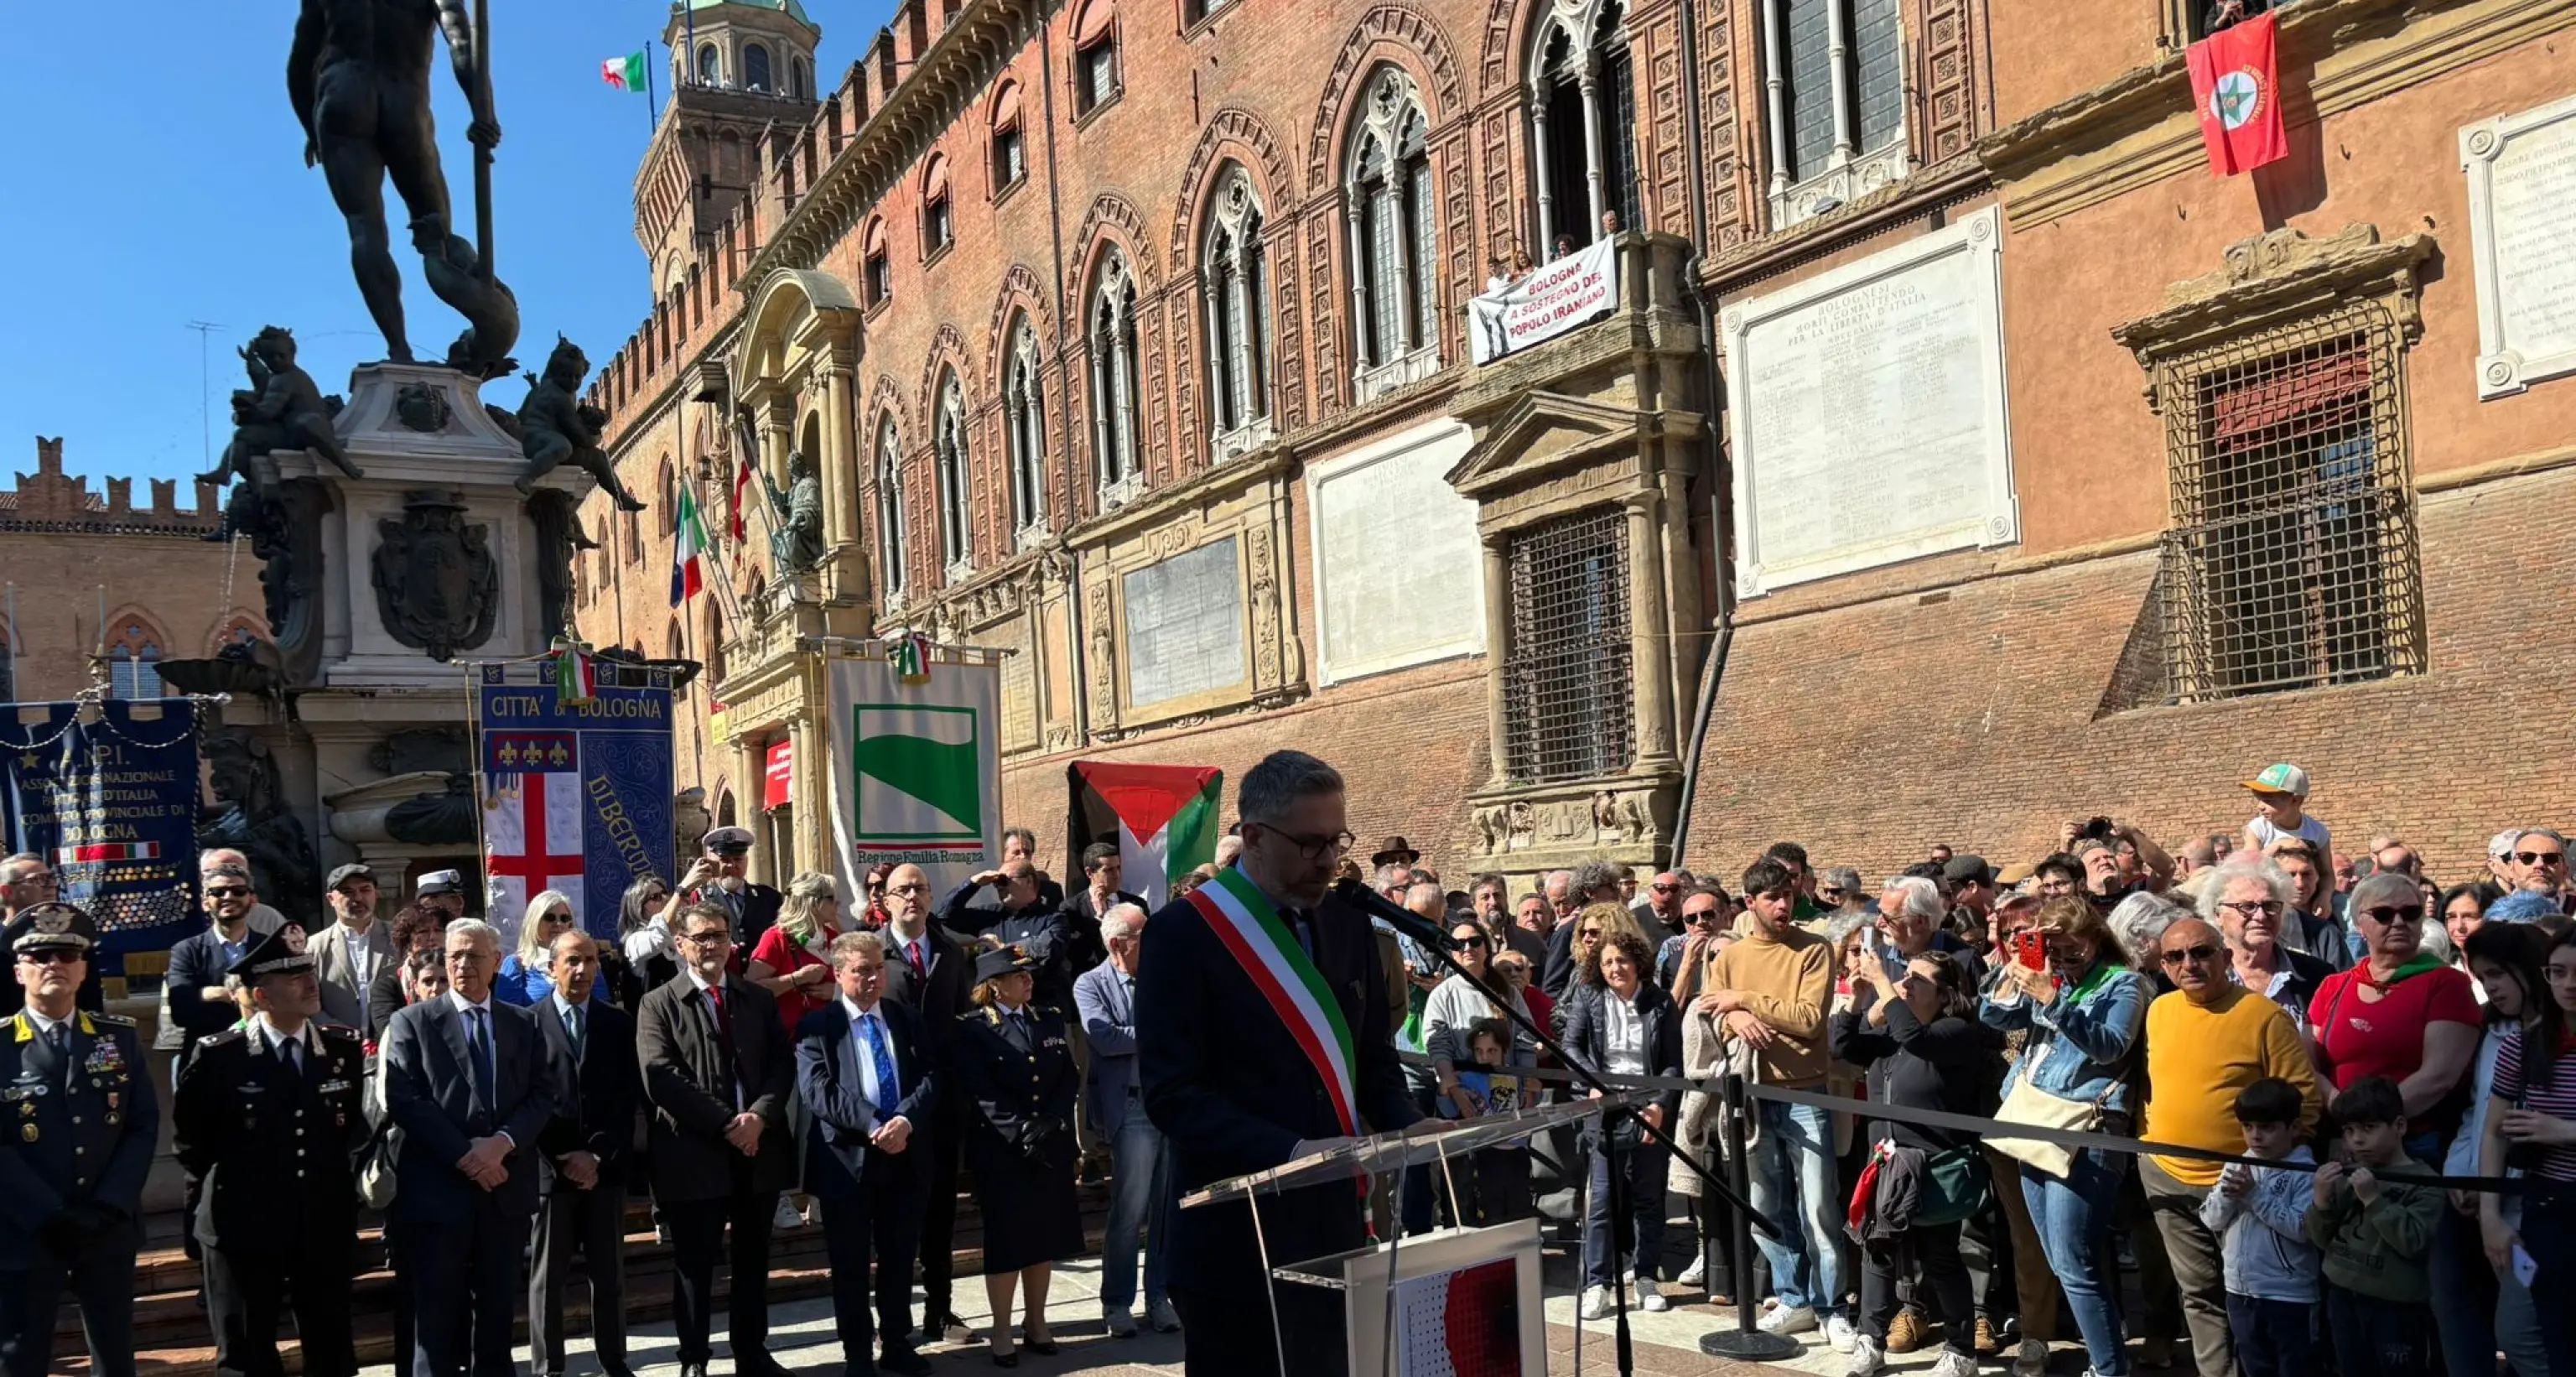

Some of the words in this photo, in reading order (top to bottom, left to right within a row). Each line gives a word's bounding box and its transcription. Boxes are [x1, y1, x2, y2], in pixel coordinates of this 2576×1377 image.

[1529, 262, 1582, 295] BOLOGNA
[1509, 313, 1550, 338] POPOLO
[1553, 286, 1606, 320] IRANIANO
[1510, 309, 1518, 320] A
[1521, 281, 1580, 316] SOSTEGNO
[1795, 317, 1827, 335] MORTI
[1834, 286, 1915, 318] COMBATTENDO
[1818, 283, 1889, 314] BOLOGNESI
[1788, 334, 1805, 347] PER
[1811, 328, 1825, 339] LA
[491, 694, 544, 717] CITTA'
[579, 698, 661, 719] BOLOGNA
[104, 769, 176, 784] NAZIONALE
[104, 788, 159, 802] D'ITALIA
[171, 804, 185, 815] DI
